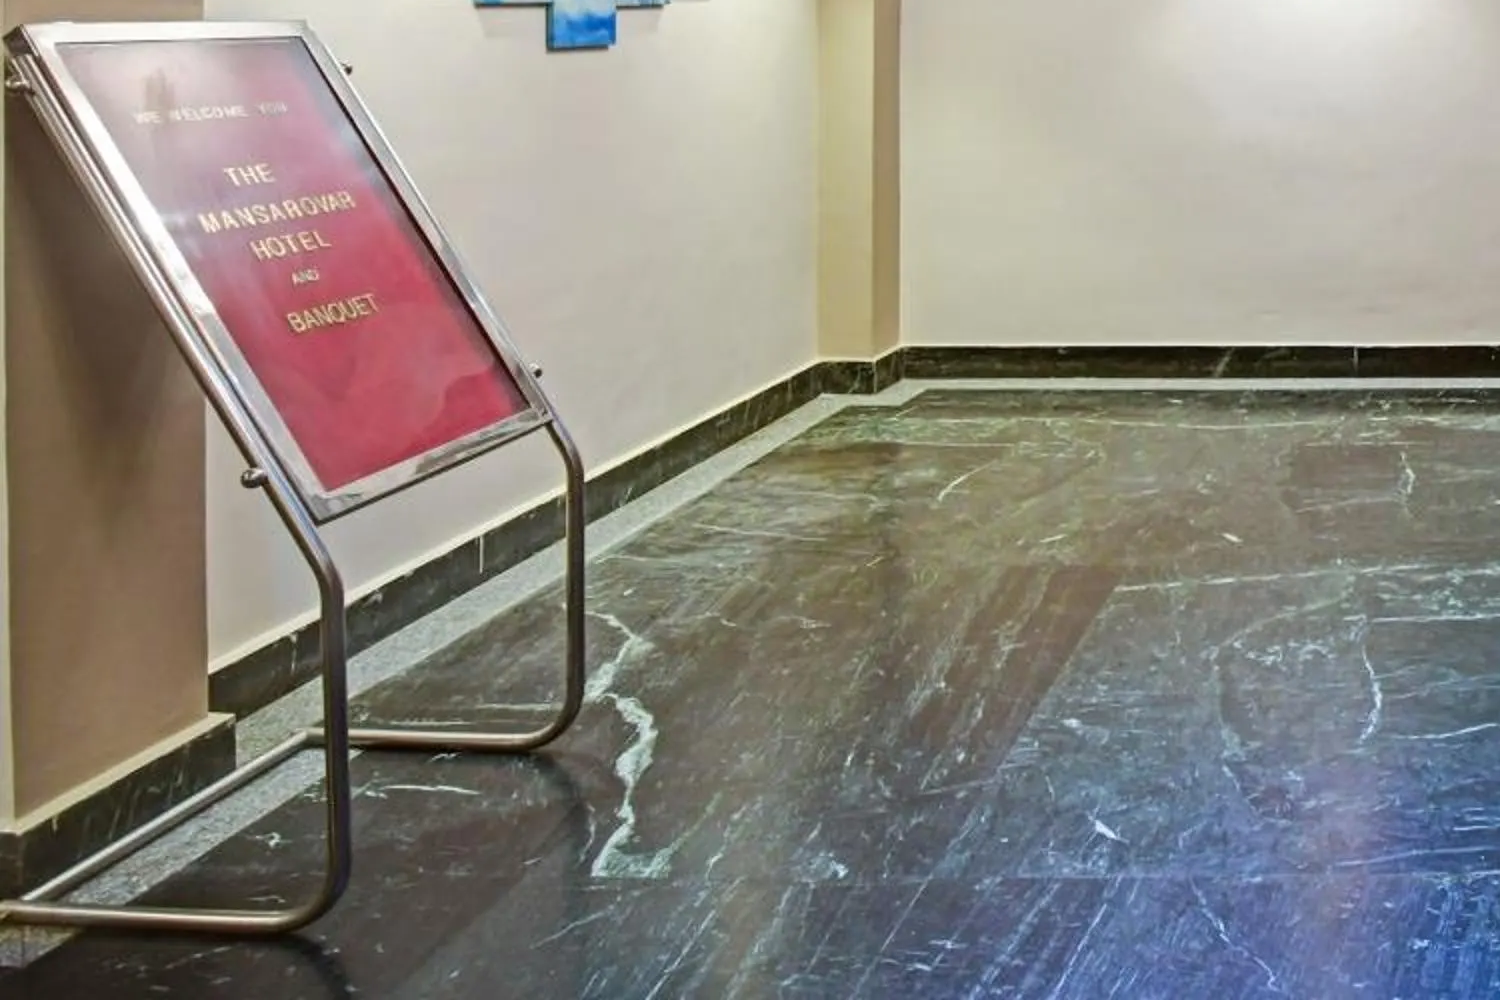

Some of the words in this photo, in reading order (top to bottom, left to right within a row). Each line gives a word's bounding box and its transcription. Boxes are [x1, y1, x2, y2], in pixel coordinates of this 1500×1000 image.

[134, 110, 162, 124] WE
[170, 105, 250, 121] WELCOME
[223, 163, 277, 187] THE
[198, 190, 357, 234] MANSAROVAR
[249, 230, 333, 262] HOTEL
[290, 267, 321, 286] AND
[286, 293, 380, 334] BANQUET
